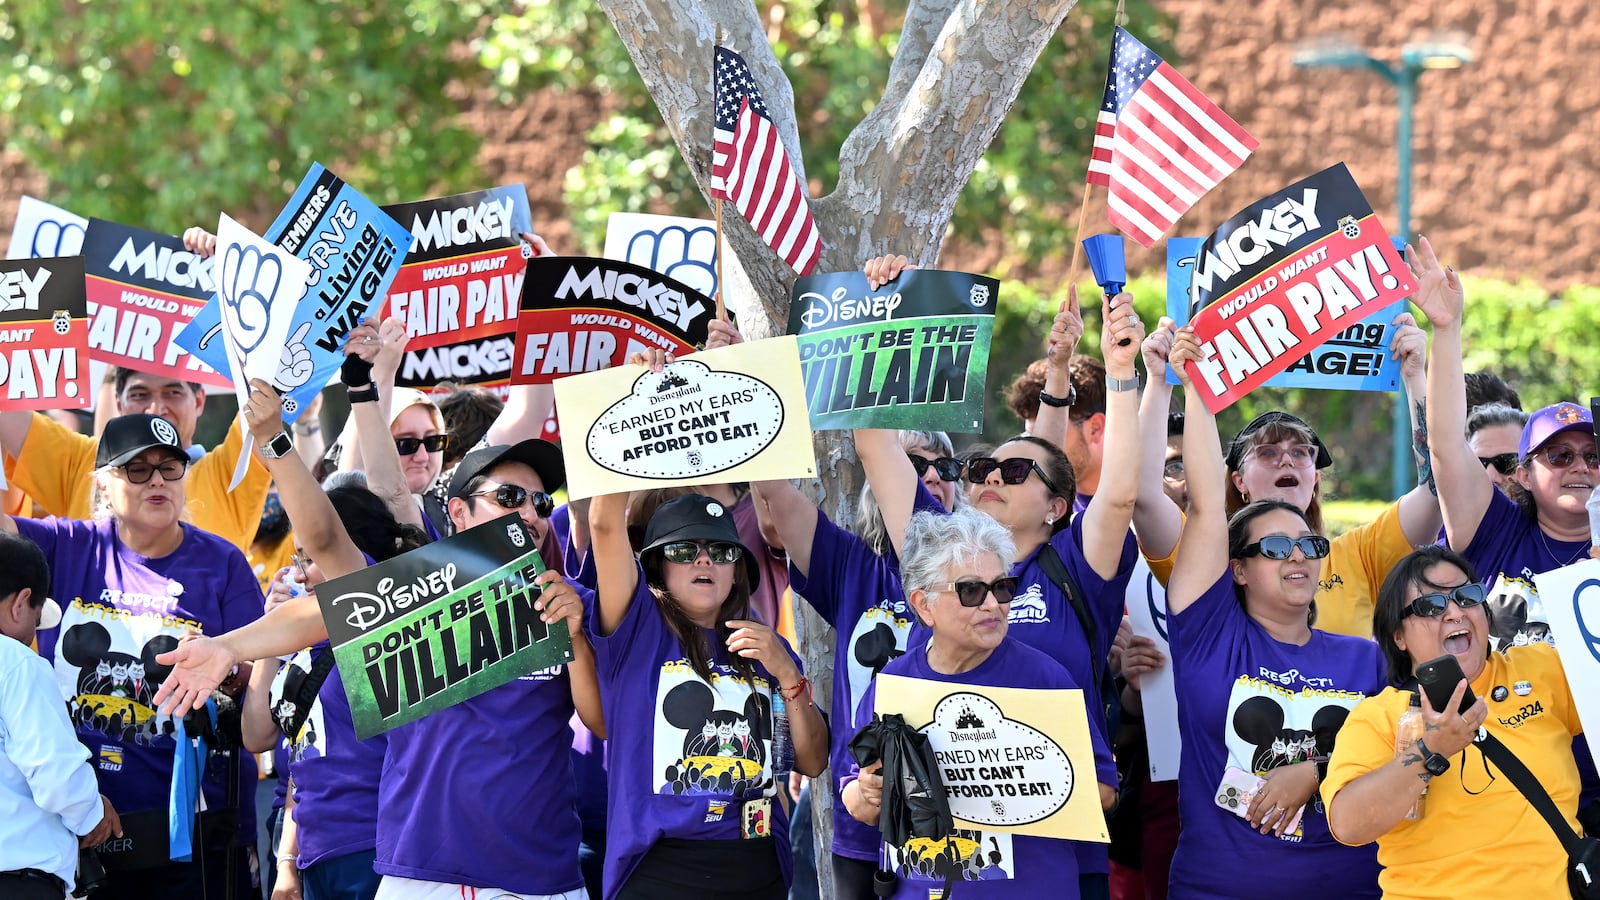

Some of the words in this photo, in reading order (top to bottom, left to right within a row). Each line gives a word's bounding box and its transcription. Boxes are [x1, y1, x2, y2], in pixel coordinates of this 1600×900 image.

[408, 195, 514, 254] MICKEY
[108, 236, 217, 293] MICK
[299, 199, 358, 301] ERVE
[318, 222, 380, 310] Living
[1192, 188, 1321, 305] MICKEY
[422, 262, 468, 282] WOULD
[470, 255, 508, 273] WANT
[1217, 275, 1278, 320] WOULD
[1278, 245, 1329, 282] WANT
[0, 266, 52, 312] EY
[120, 290, 179, 314] WOULD
[315, 235, 397, 355] WAGE!
[390, 284, 460, 339] FAIR
[465, 273, 524, 328] PAY
[554, 264, 706, 333] MICKEY
[314, 307, 327, 321] a
[570, 313, 632, 330] WOULD
[634, 323, 679, 353] WANT
[1194, 303, 1301, 397] FAIR
[1284, 243, 1399, 335] PAY!
[521, 330, 617, 376] FAIR
[800, 332, 876, 361] DON'T
[878, 328, 916, 349] BE
[921, 324, 979, 344] THE
[0, 347, 79, 399] AY!
[801, 344, 974, 416] VILLAIN
[602, 406, 676, 435] "EARNED
[679, 399, 704, 416] MY
[709, 387, 758, 409] EARS"
[648, 383, 702, 406] Disneyland
[623, 436, 692, 462] AFFORD
[694, 430, 718, 447] TO
[720, 422, 760, 442] EAT!
[639, 422, 674, 442] BUT
[678, 410, 731, 432] CAN'T
[73, 597, 132, 622] BETTER
[100, 588, 179, 613] RESPECT!
[362, 608, 445, 665] DON'T
[449, 590, 486, 623] BE
[488, 563, 537, 603] THE
[365, 585, 550, 721] VILLAIN
[1238, 674, 1295, 701] BETTER
[1301, 685, 1363, 700] WAGES!
[1259, 666, 1334, 688] RESPECT!
[935, 750, 976, 765] RNED
[978, 748, 1000, 763] MY
[1004, 745, 1048, 762] EARS"
[947, 728, 997, 743] Disneyland
[99, 762, 122, 771] SEIU
[944, 767, 976, 781] BUT
[978, 765, 1025, 780] CAN'T
[943, 784, 994, 798] FFORD
[994, 783, 1017, 797] TO
[1018, 782, 1054, 796] EAT!
[704, 814, 723, 823] SEIU
